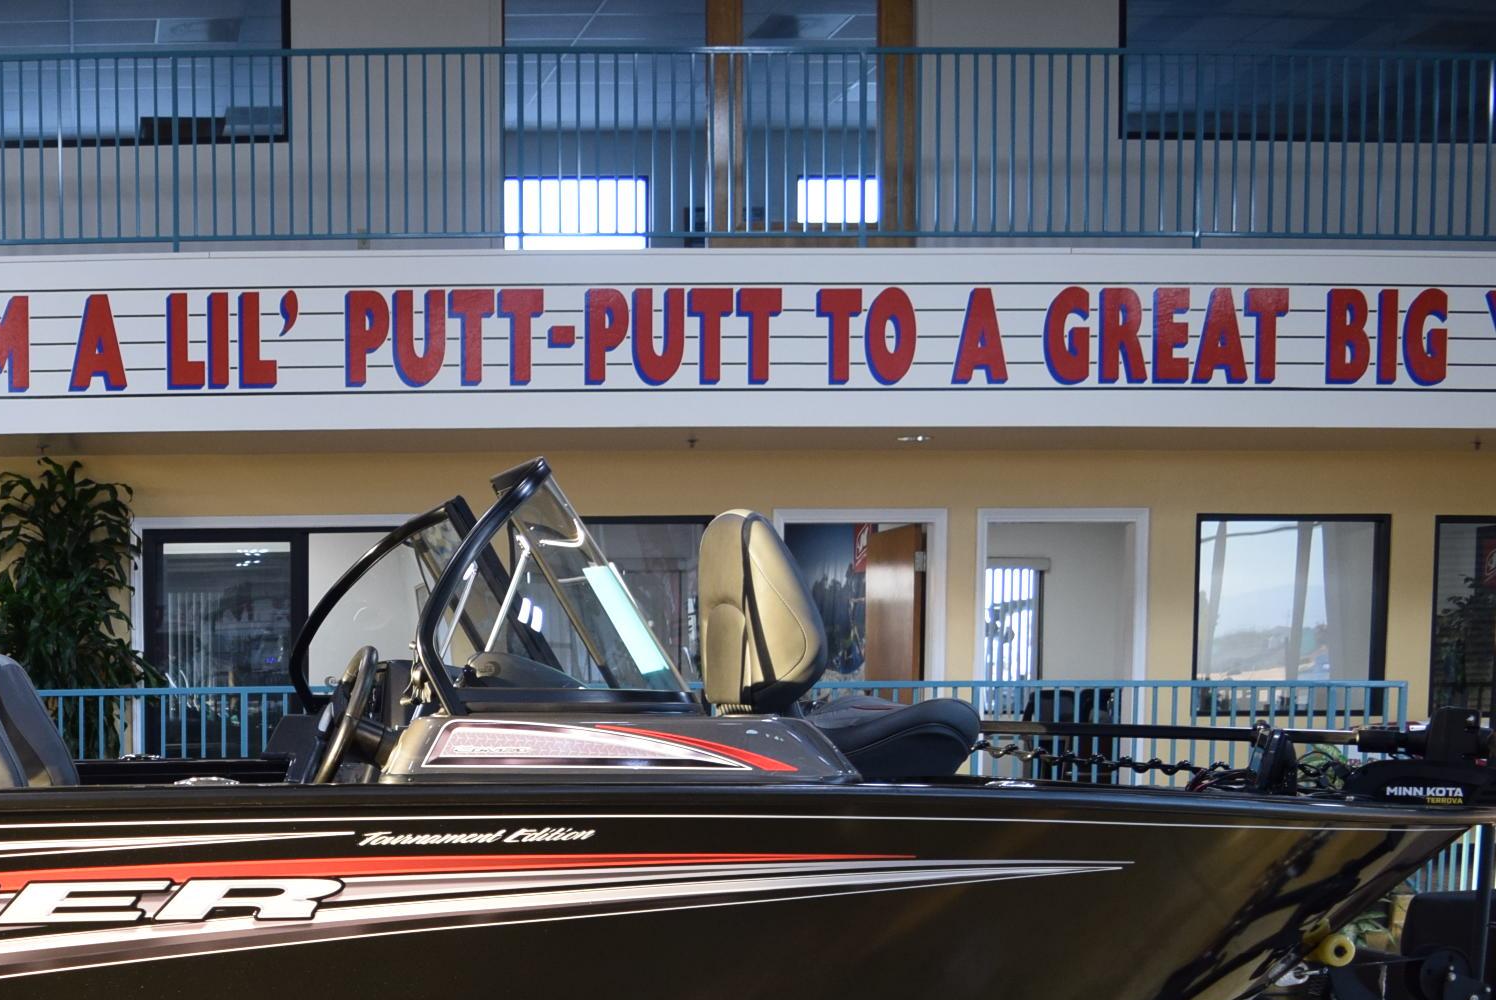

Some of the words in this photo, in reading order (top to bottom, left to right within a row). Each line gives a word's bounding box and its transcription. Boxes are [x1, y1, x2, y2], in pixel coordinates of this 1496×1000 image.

[68, 293, 128, 393] A
[166, 290, 299, 390] LIL'
[345, 287, 783, 388] PUTT-PUTT
[816, 286, 917, 387] TO
[950, 287, 1009, 385] A
[1043, 286, 1290, 386] GREAT
[1325, 287, 1449, 386] BIG
[1385, 786, 1424, 796] MINN
[1426, 786, 1464, 797] KOTA
[358, 829, 506, 847] Tournament
[503, 828, 596, 844] Edition
